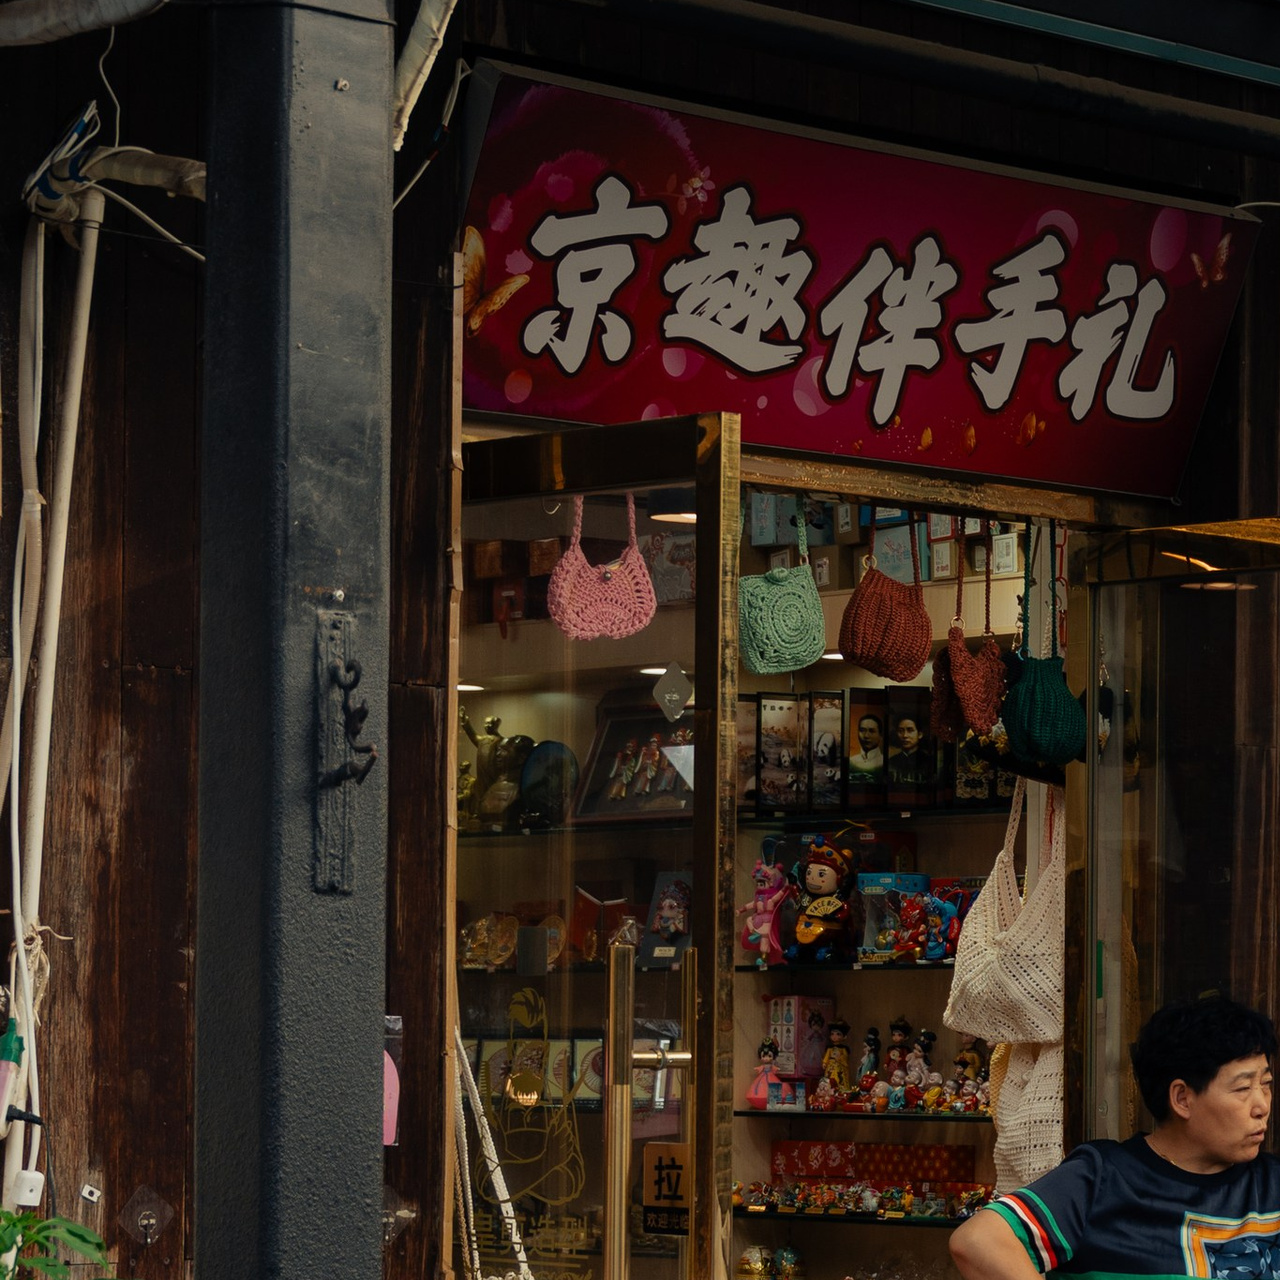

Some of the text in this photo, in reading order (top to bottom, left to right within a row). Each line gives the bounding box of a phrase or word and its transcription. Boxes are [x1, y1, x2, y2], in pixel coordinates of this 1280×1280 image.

[522, 175, 1176, 427] 京趣伴手礼
[654, 1156, 684, 1201] 拉
